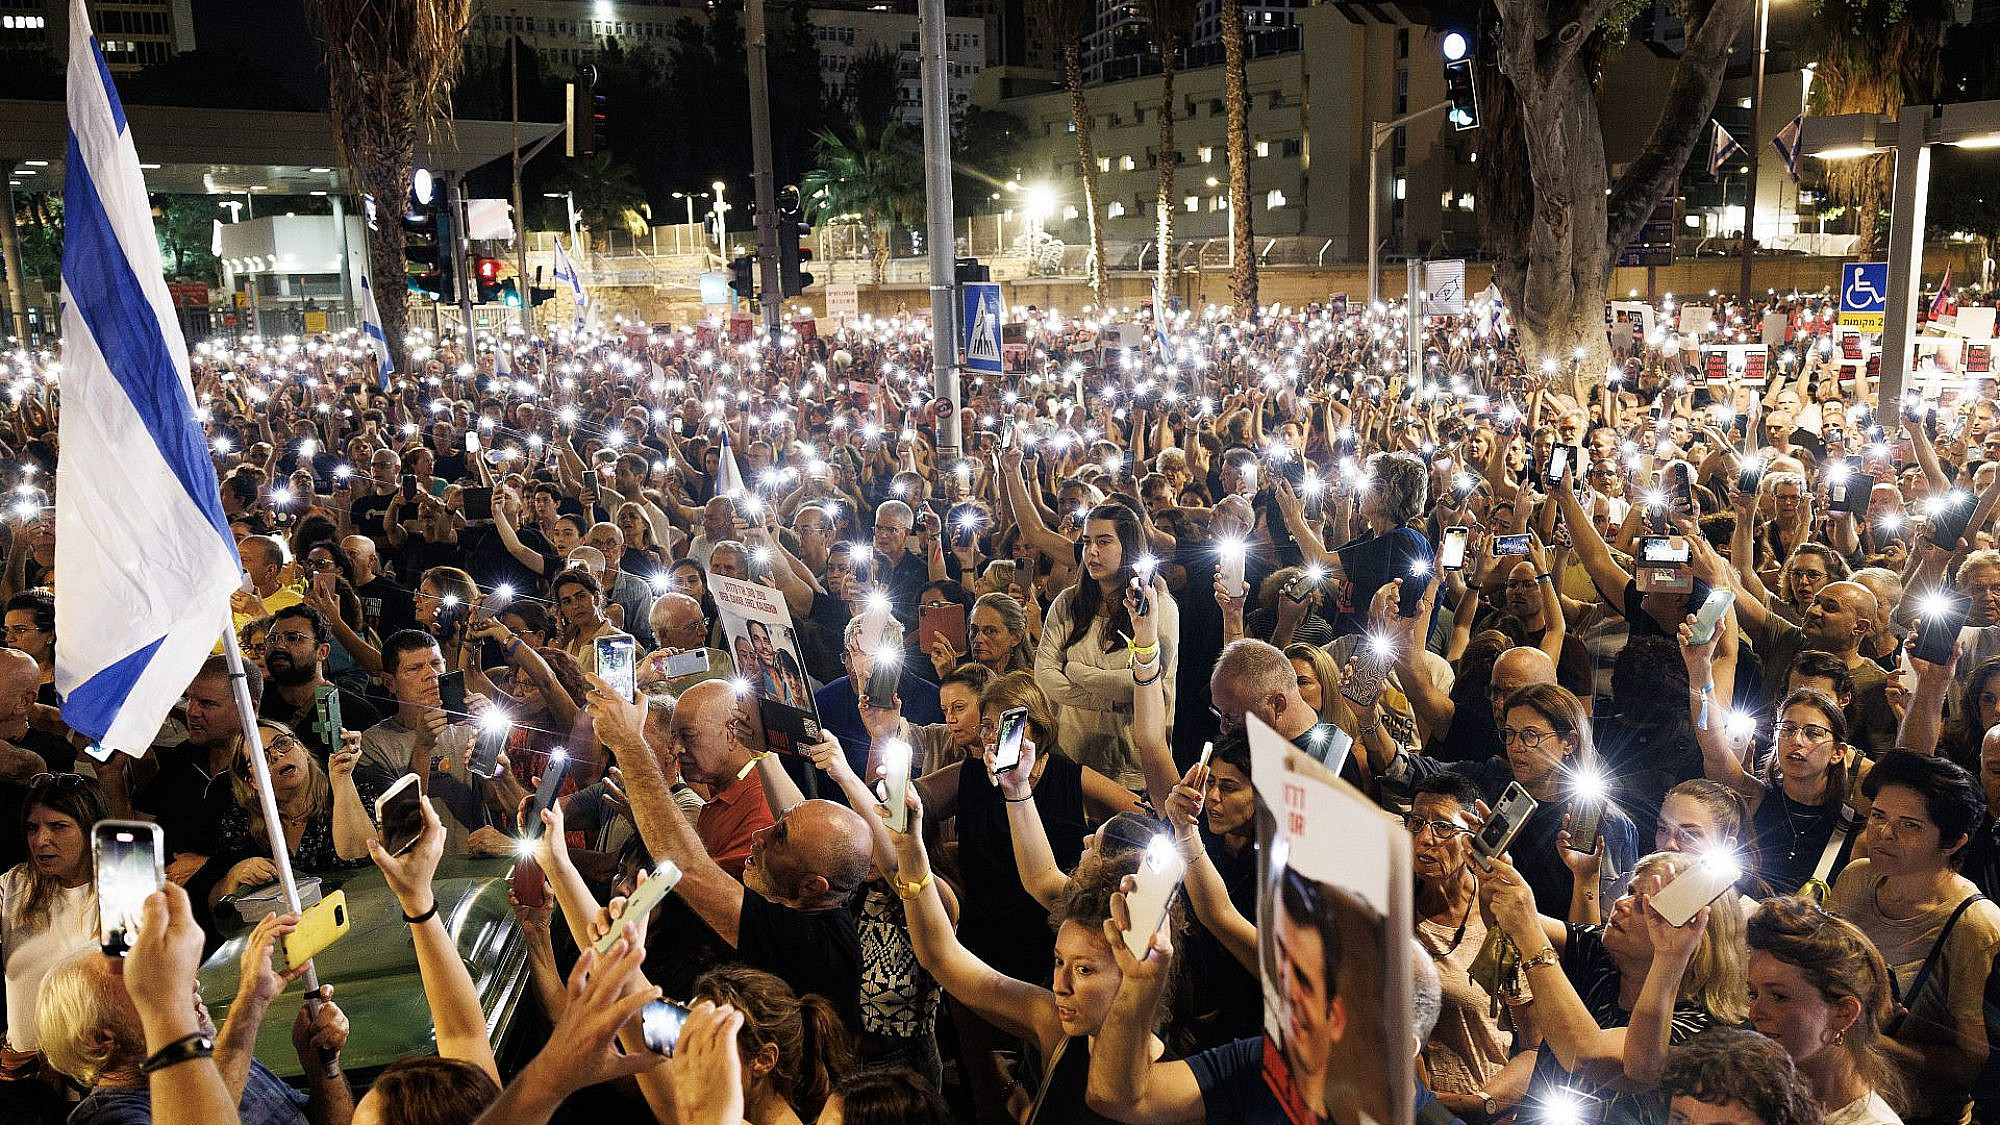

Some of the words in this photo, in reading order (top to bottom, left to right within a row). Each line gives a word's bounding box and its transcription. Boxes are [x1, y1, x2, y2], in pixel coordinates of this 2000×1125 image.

[1843, 319, 1875, 328] מקומות
[1878, 317, 1883, 326] 2
[1381, 714, 1414, 729] RING
